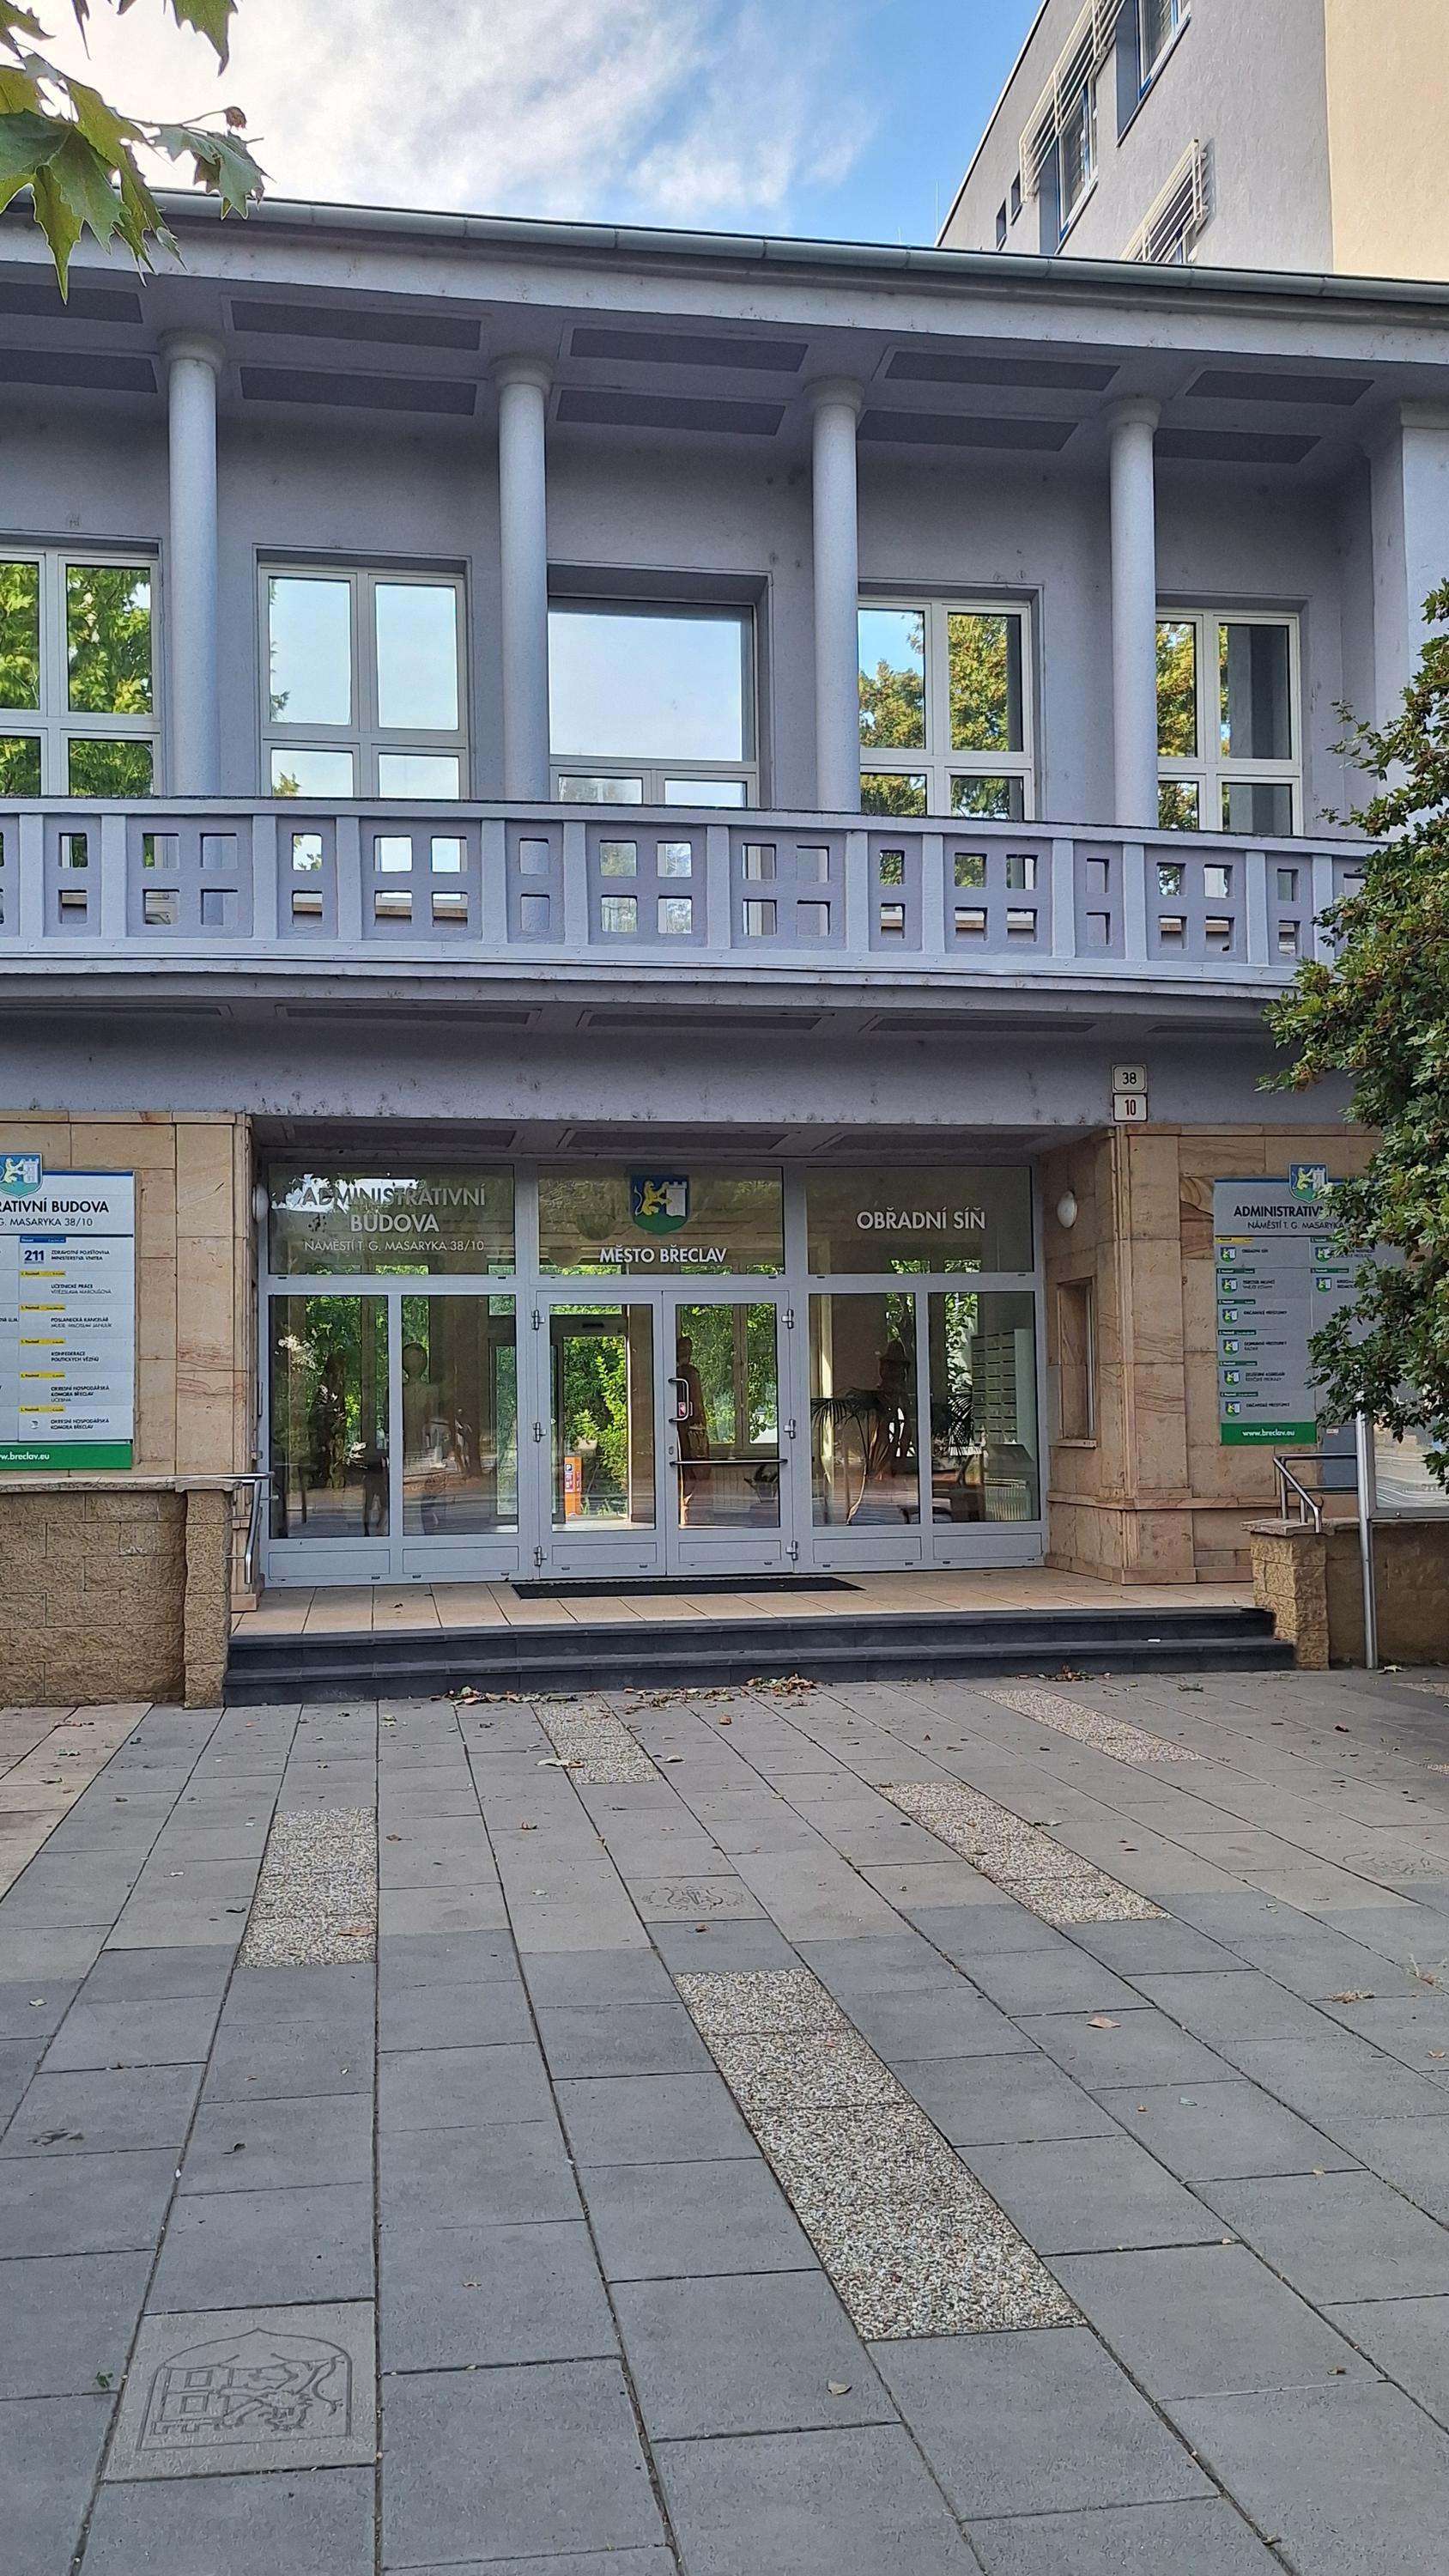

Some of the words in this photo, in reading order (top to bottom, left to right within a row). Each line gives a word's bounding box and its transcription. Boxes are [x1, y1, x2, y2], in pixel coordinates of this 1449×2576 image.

[1122, 1072, 1137, 1084] 38
[1125, 1099, 1137, 1115] 10
[302, 1183, 486, 1206] ADMINISTRATIVNÍ
[0, 1197, 47, 1212] ATIVNÍ
[52, 1200, 110, 1212] BUDOVA
[857, 1206, 947, 1230] OBŘADNÍ
[953, 1206, 986, 1230] SÍŇ
[1234, 1206, 1332, 1217] ADMINISTRATIV
[9, 1218, 62, 1226] MASARYKA
[64, 1218, 93, 1227] 38/10
[350, 1214, 440, 1232] BUDOVA
[1247, 1219, 1282, 1230] NÁMĚSTÍ
[304, 1237, 355, 1251] NÁMĚSTÍ
[357, 1240, 365, 1251] T.
[368, 1240, 381, 1252] G.
[385, 1240, 447, 1251] MASARYKA
[450, 1240, 484, 1252] 38/10
[24, 1250, 44, 1261] 211
[599, 1244, 655, 1263] MĚSTO
[660, 1244, 727, 1263] BŘECLAV
[1242, 1428, 1295, 1437] www.breclav.eu
[0, 1451, 50, 1461] w.breclav.eu
